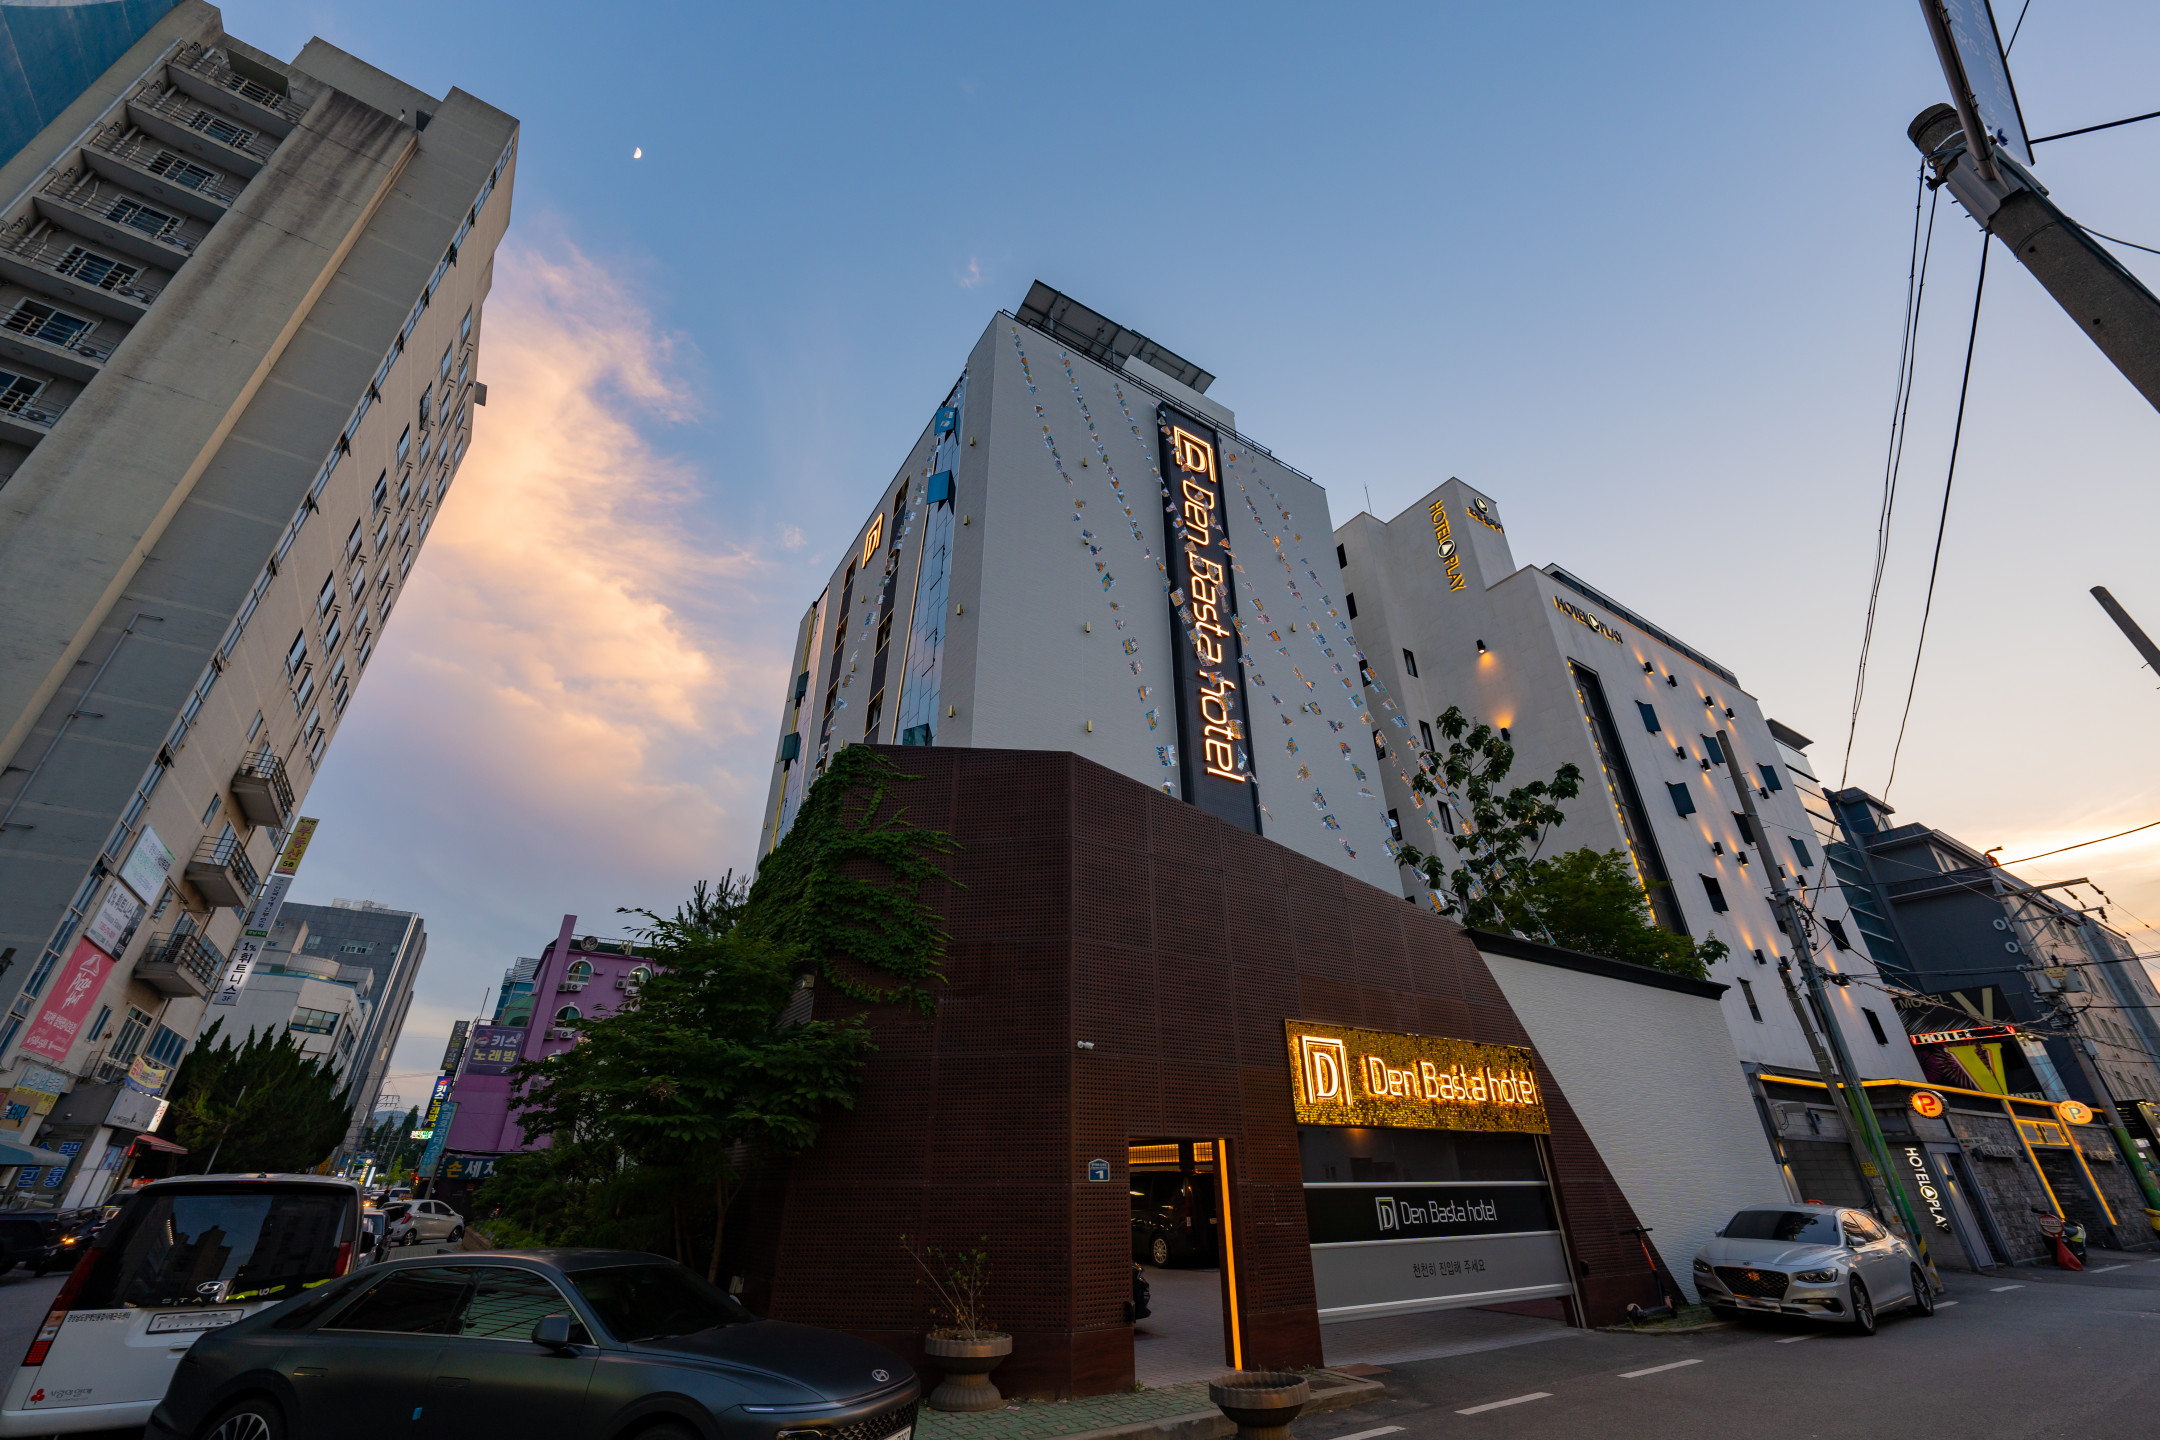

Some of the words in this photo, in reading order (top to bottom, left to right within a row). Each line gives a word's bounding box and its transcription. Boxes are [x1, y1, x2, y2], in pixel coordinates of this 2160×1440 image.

[1182, 479, 1215, 546] Den
[1429, 500, 1451, 545] HOTEL
[1443, 554, 1467, 592] PLAY
[1188, 551, 1231, 664] Basta
[1553, 595, 1588, 626] HOTEL
[1598, 620, 1624, 645] PLAY
[1199, 669, 1246, 782] hotel
[1156, 747, 1168, 766] OPEN
[286, 825, 311, 861] 부동산
[242, 941, 257, 952] 1%
[66, 972, 92, 994] Pizza
[61, 991, 85, 1010] Hut
[1900, 994, 1950, 1010] MOTEL
[1950, 986, 1994, 1026] V
[490, 1035, 517, 1048] 키스
[473, 1048, 517, 1063] 노래방
[1368, 1056, 1418, 1096] Den
[1420, 1061, 1487, 1102] Basta
[1486, 1066, 1540, 1105] hotel
[1947, 1043, 2009, 1100] V
[1917, 1095, 1935, 1113] P
[2068, 1106, 2081, 1120] P
[1095, 1169, 1104, 1179] 1
[1904, 1147, 1931, 1187] HOTEL
[1927, 1199, 1950, 1231] PLAY
[1400, 1201, 1428, 1224] Den
[1428, 1199, 1467, 1223] Basta
[1466, 1199, 1498, 1221] hotel
[1412, 1261, 1437, 1278] 천천히
[1438, 1260, 1462, 1276] 진입해
[1463, 1259, 1486, 1274] 주세요
